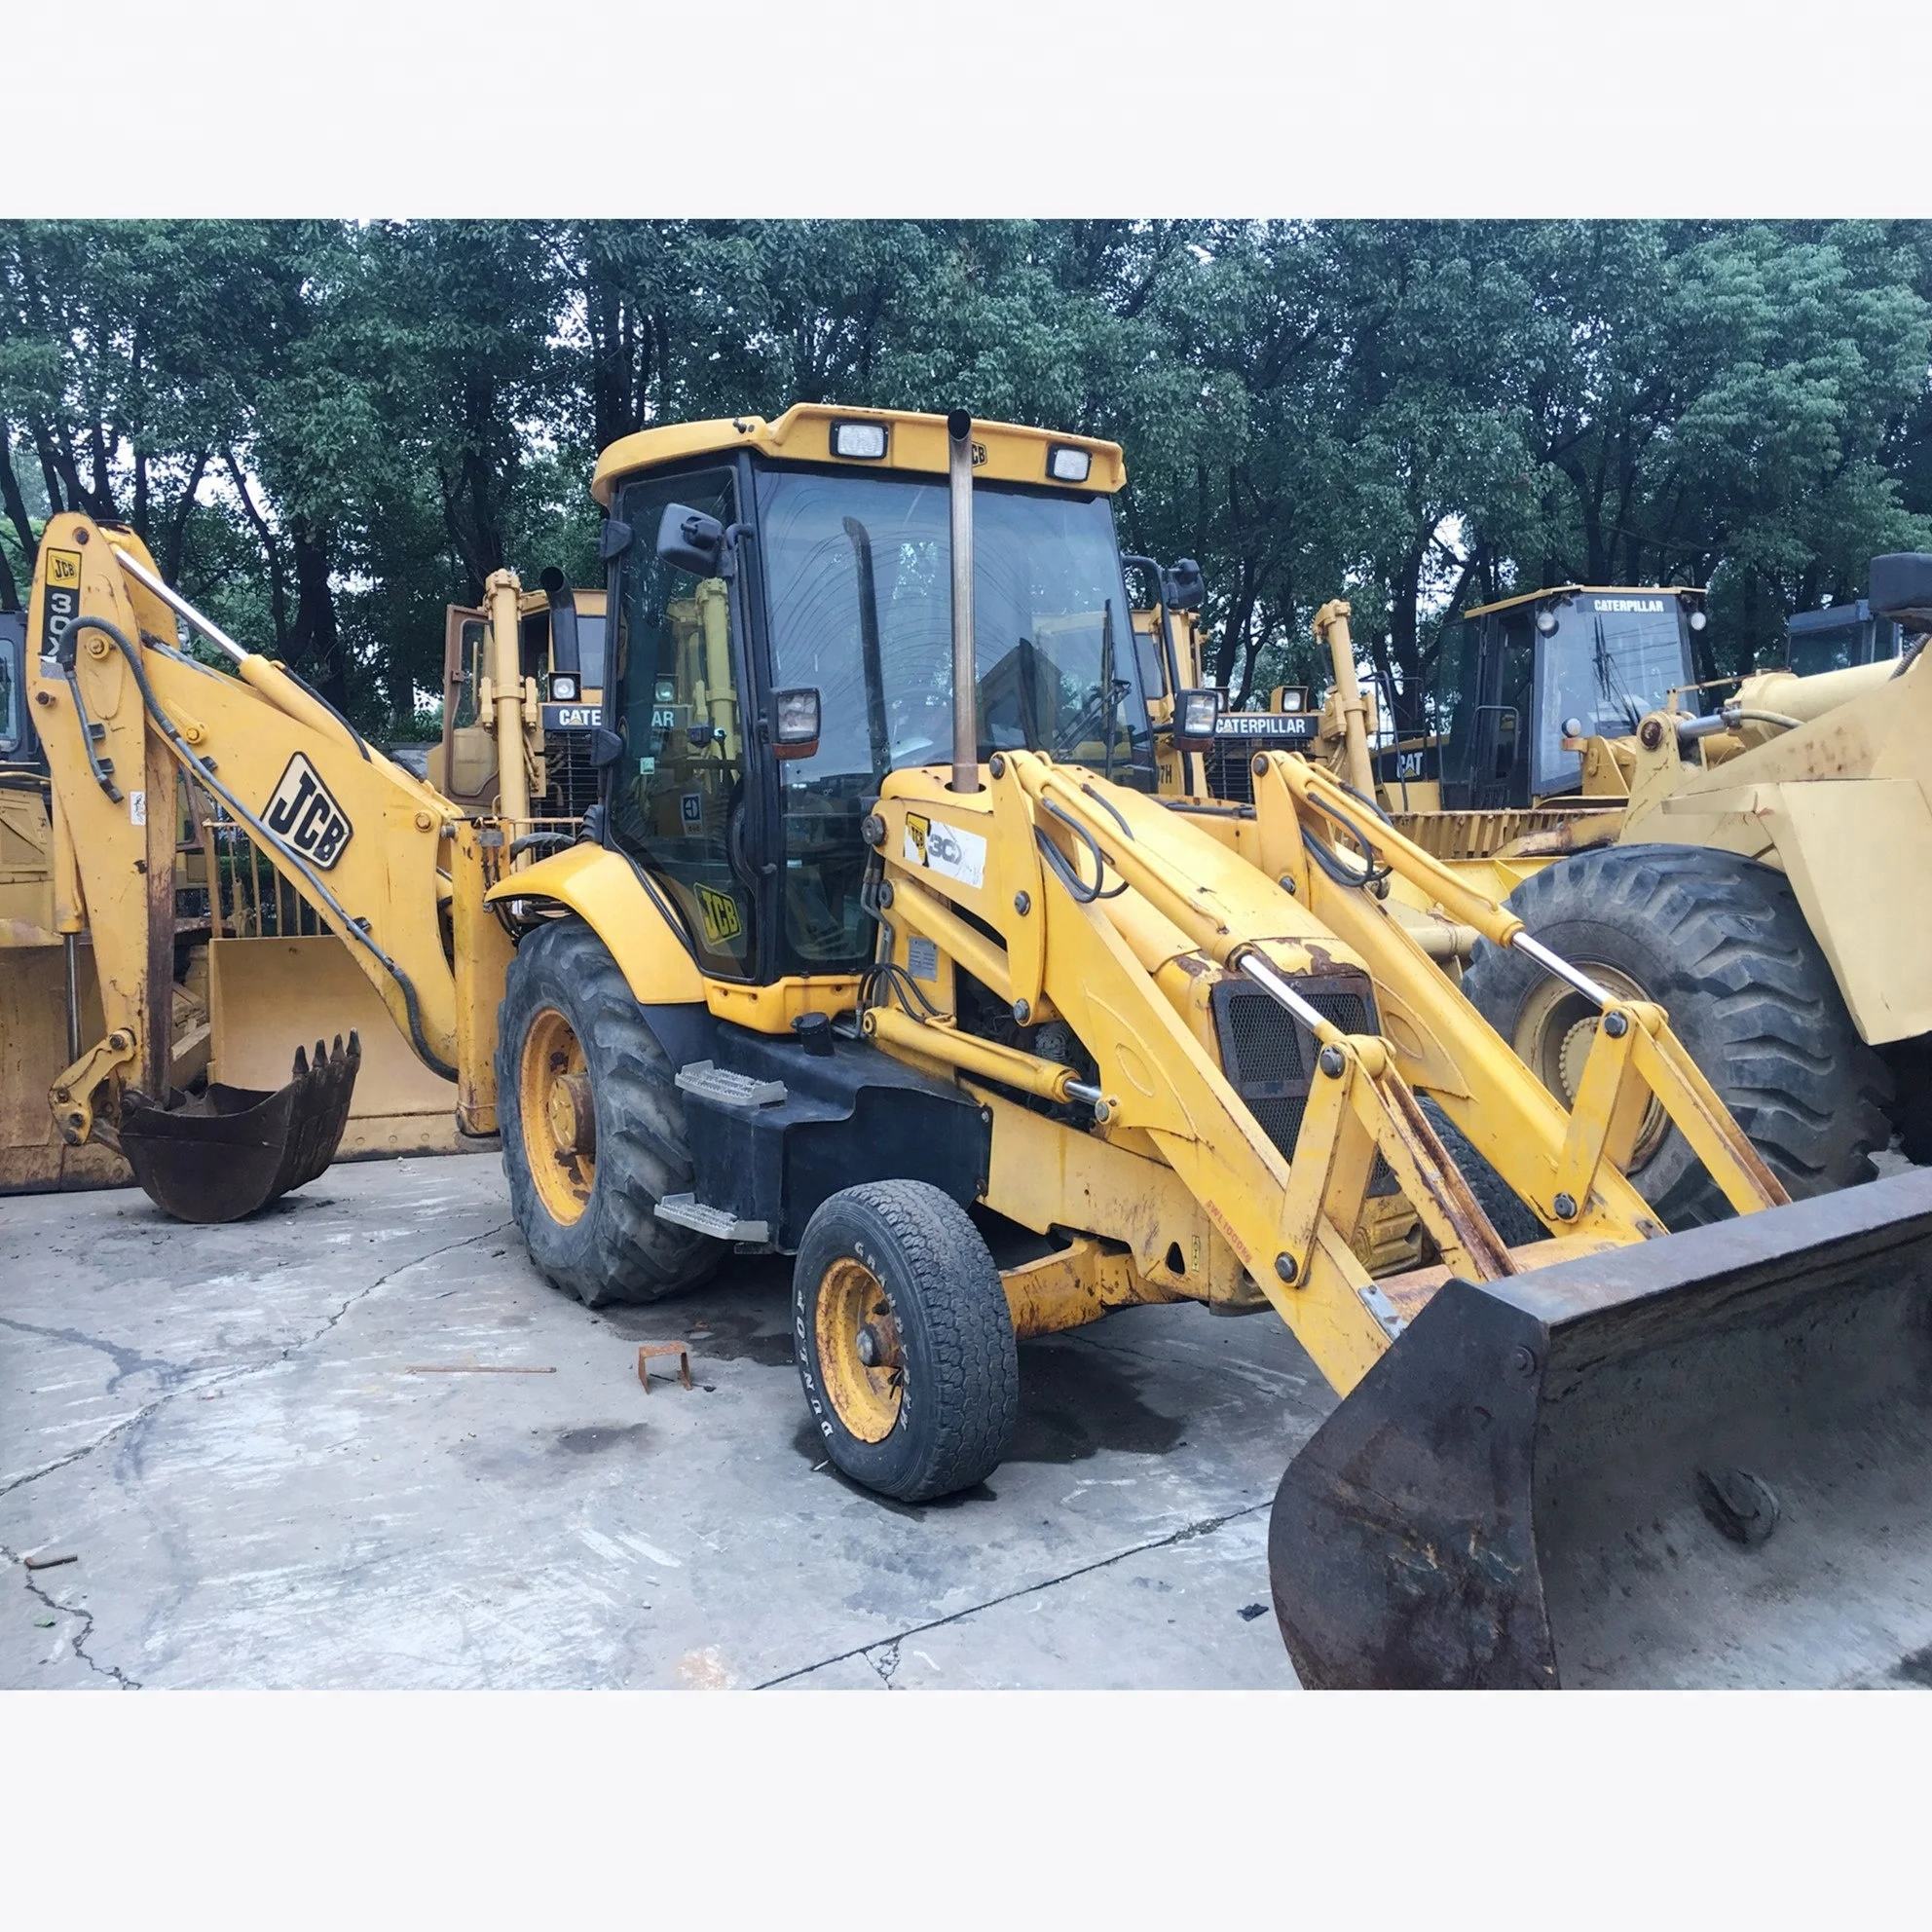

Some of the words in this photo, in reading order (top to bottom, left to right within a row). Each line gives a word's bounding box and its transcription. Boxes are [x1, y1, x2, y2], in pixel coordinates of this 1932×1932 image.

[971, 443, 985, 464] CB
[55, 558, 75, 578] JCB
[1594, 599, 1664, 613] CATERPILLAR
[1216, 718, 1306, 733] CATERPILLAR
[1396, 751, 1424, 779] CAT
[268, 770, 345, 862] JCB
[701, 890, 738, 940] JCB
[796, 1289, 835, 1438] DUNLOP
